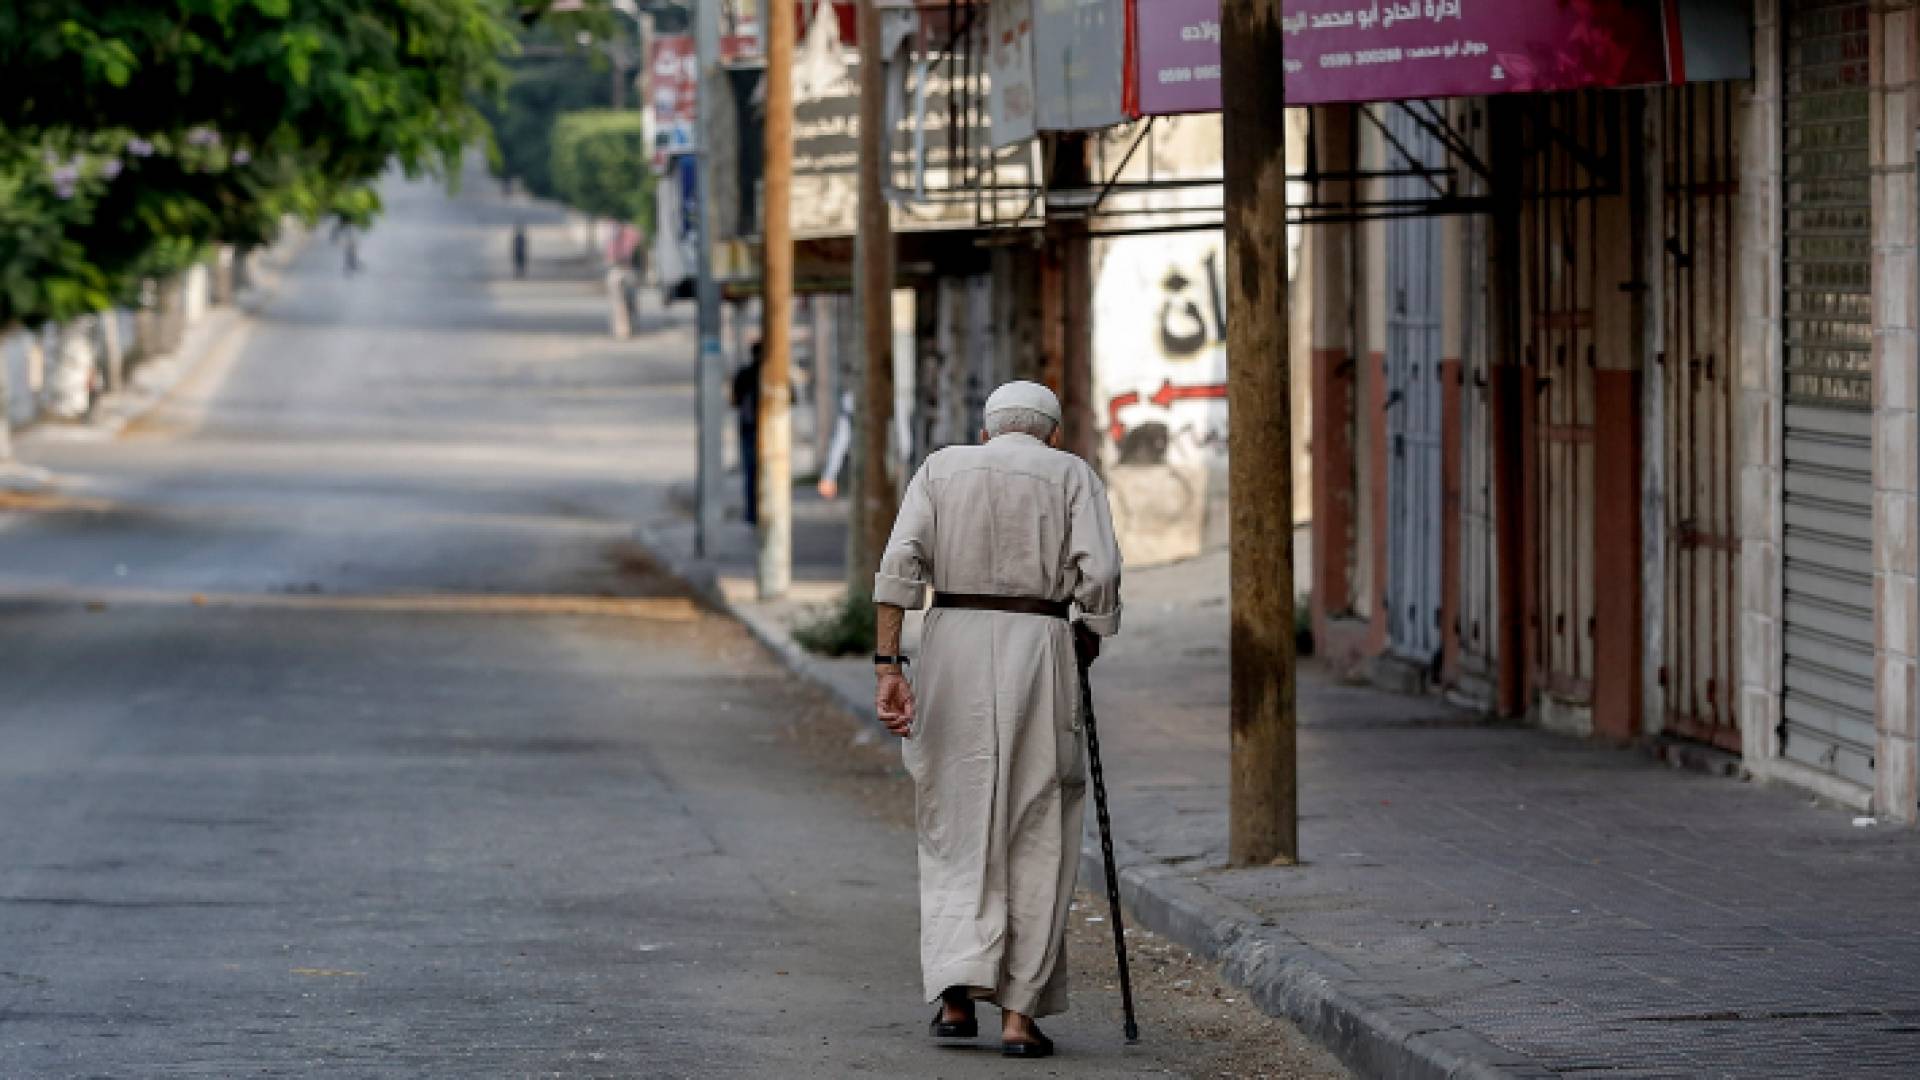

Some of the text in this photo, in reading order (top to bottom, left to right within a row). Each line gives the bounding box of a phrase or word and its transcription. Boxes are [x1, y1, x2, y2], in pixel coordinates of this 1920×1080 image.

[1311, 10, 1354, 28] محمد
[1382, 1, 1420, 28] الحاج
[1160, 250, 1227, 356] ان
